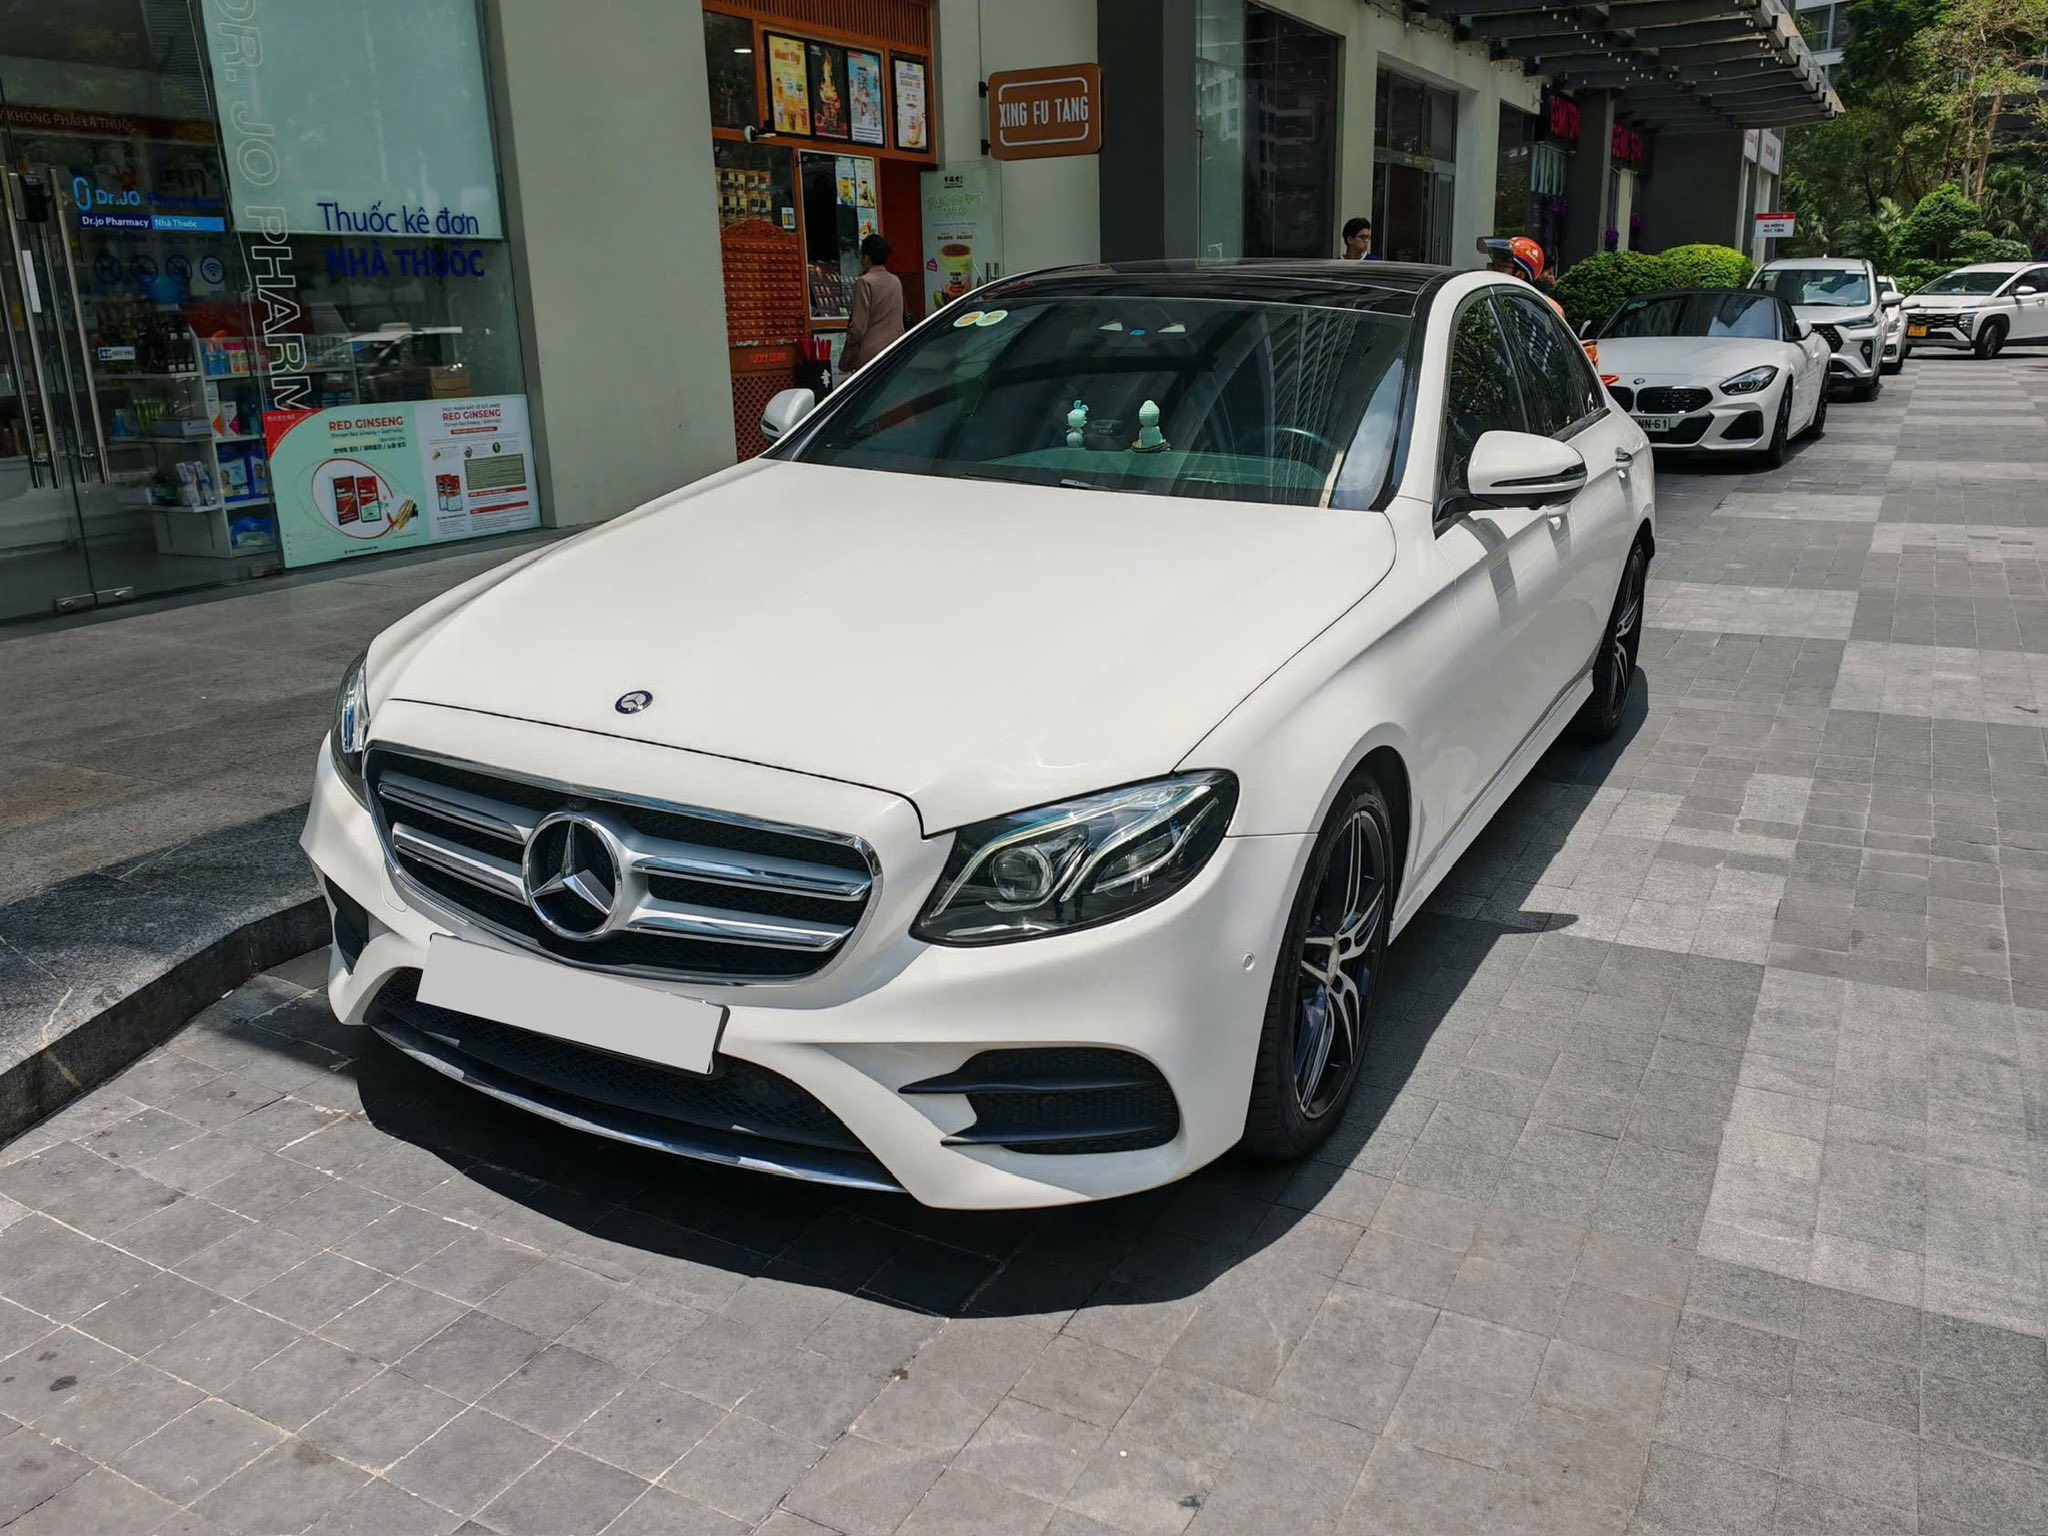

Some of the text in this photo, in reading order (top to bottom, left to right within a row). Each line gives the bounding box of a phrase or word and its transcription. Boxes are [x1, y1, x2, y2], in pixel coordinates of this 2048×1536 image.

[999, 96, 1088, 127] XING FU TANG
[230, 100, 280, 187] JO
[82, 217, 104, 226] Dr.jo
[106, 218, 149, 228] Pharmacy
[317, 201, 479, 235] Thuốc kê đơn
[327, 239, 485, 279] NHÀ THUỐC
[329, 416, 404, 431] RED GINSENG
[442, 409, 501, 422] RED GINSENG
